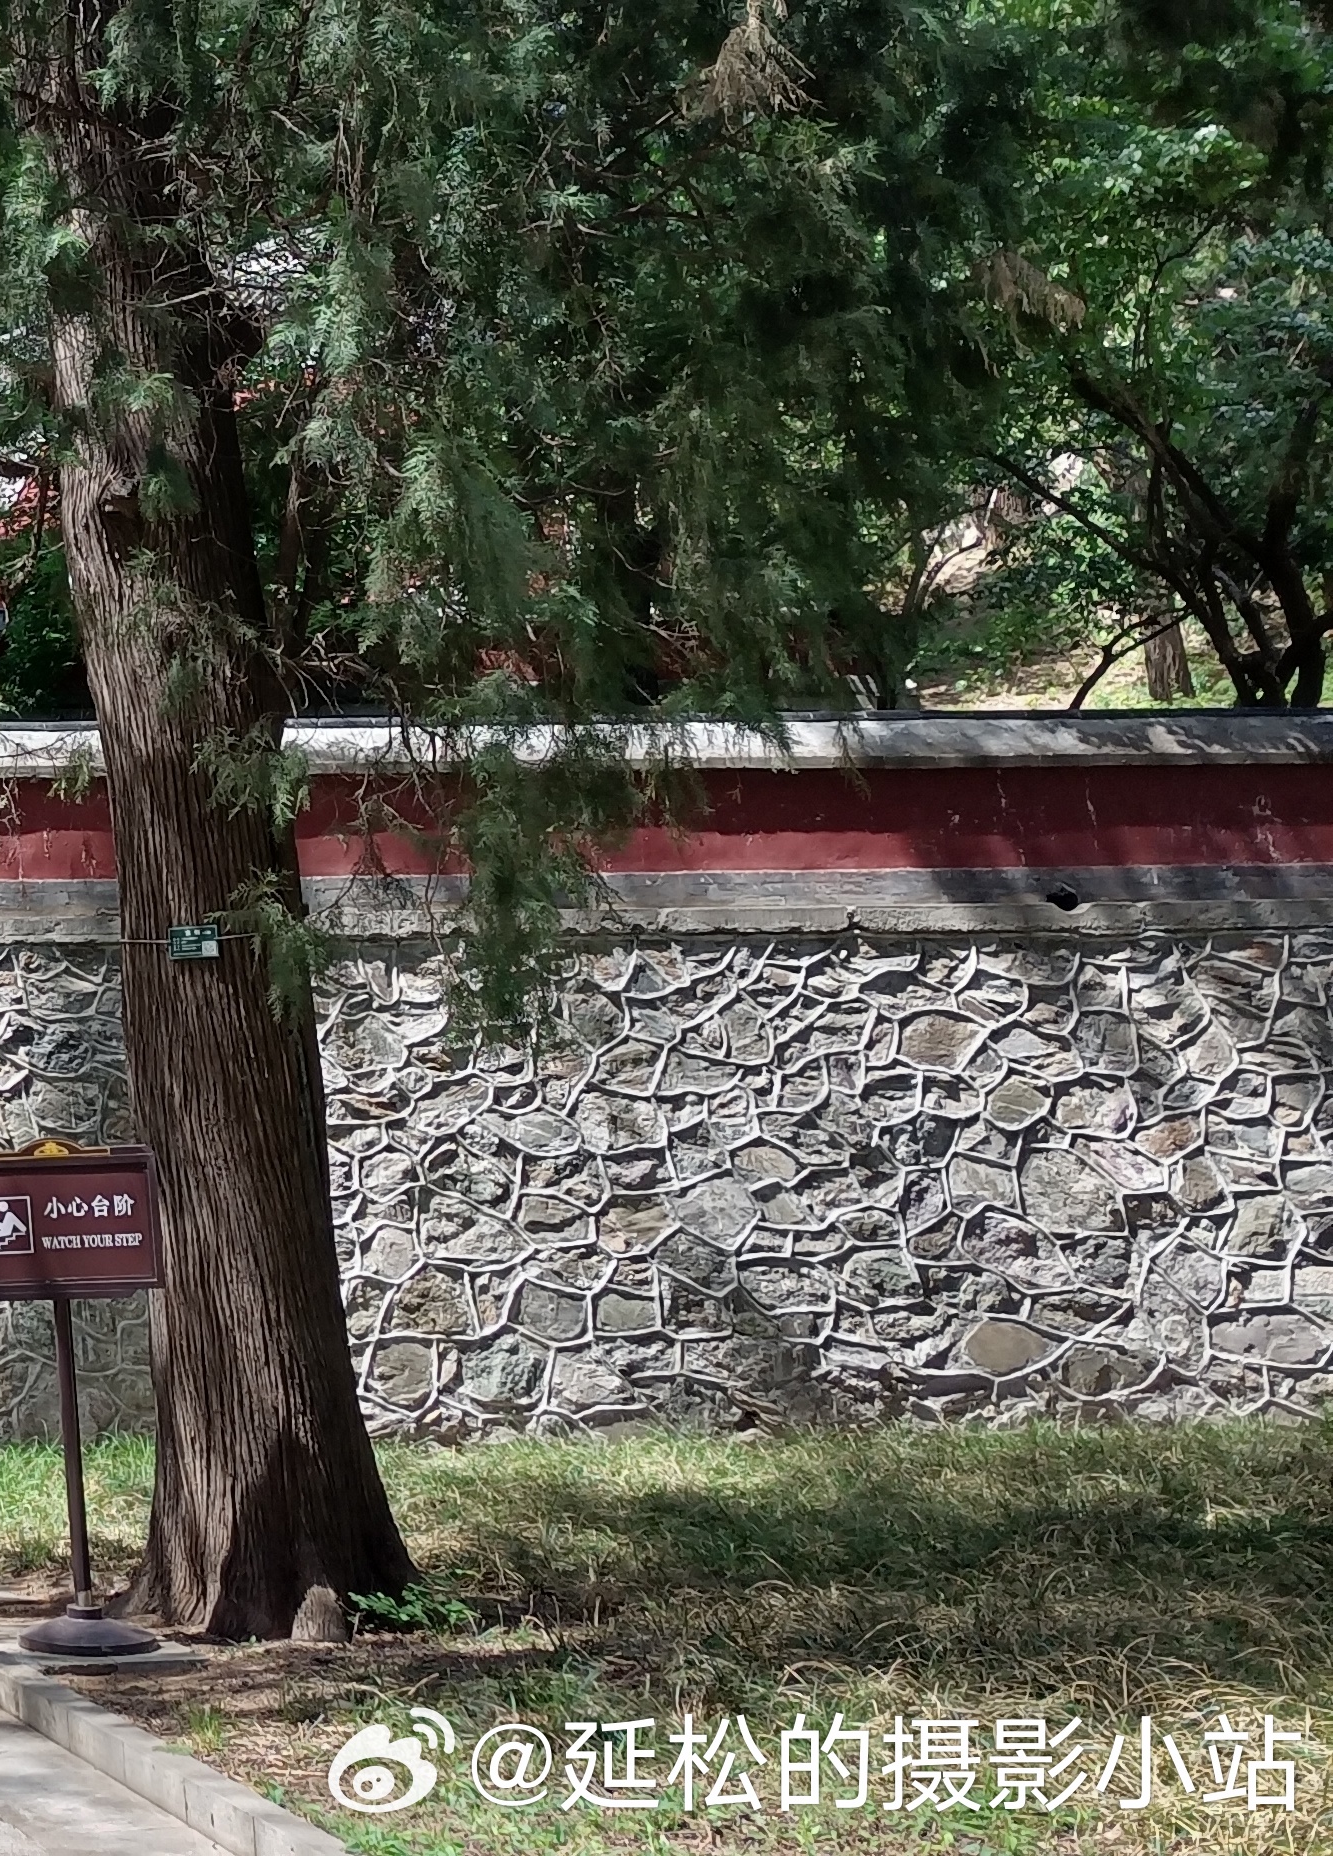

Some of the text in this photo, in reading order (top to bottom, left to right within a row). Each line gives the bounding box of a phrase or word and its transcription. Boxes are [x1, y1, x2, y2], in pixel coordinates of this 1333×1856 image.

[43, 1193, 135, 1219] 小心台阶
[41, 1233, 143, 1249] WATCH YOUR STEP
